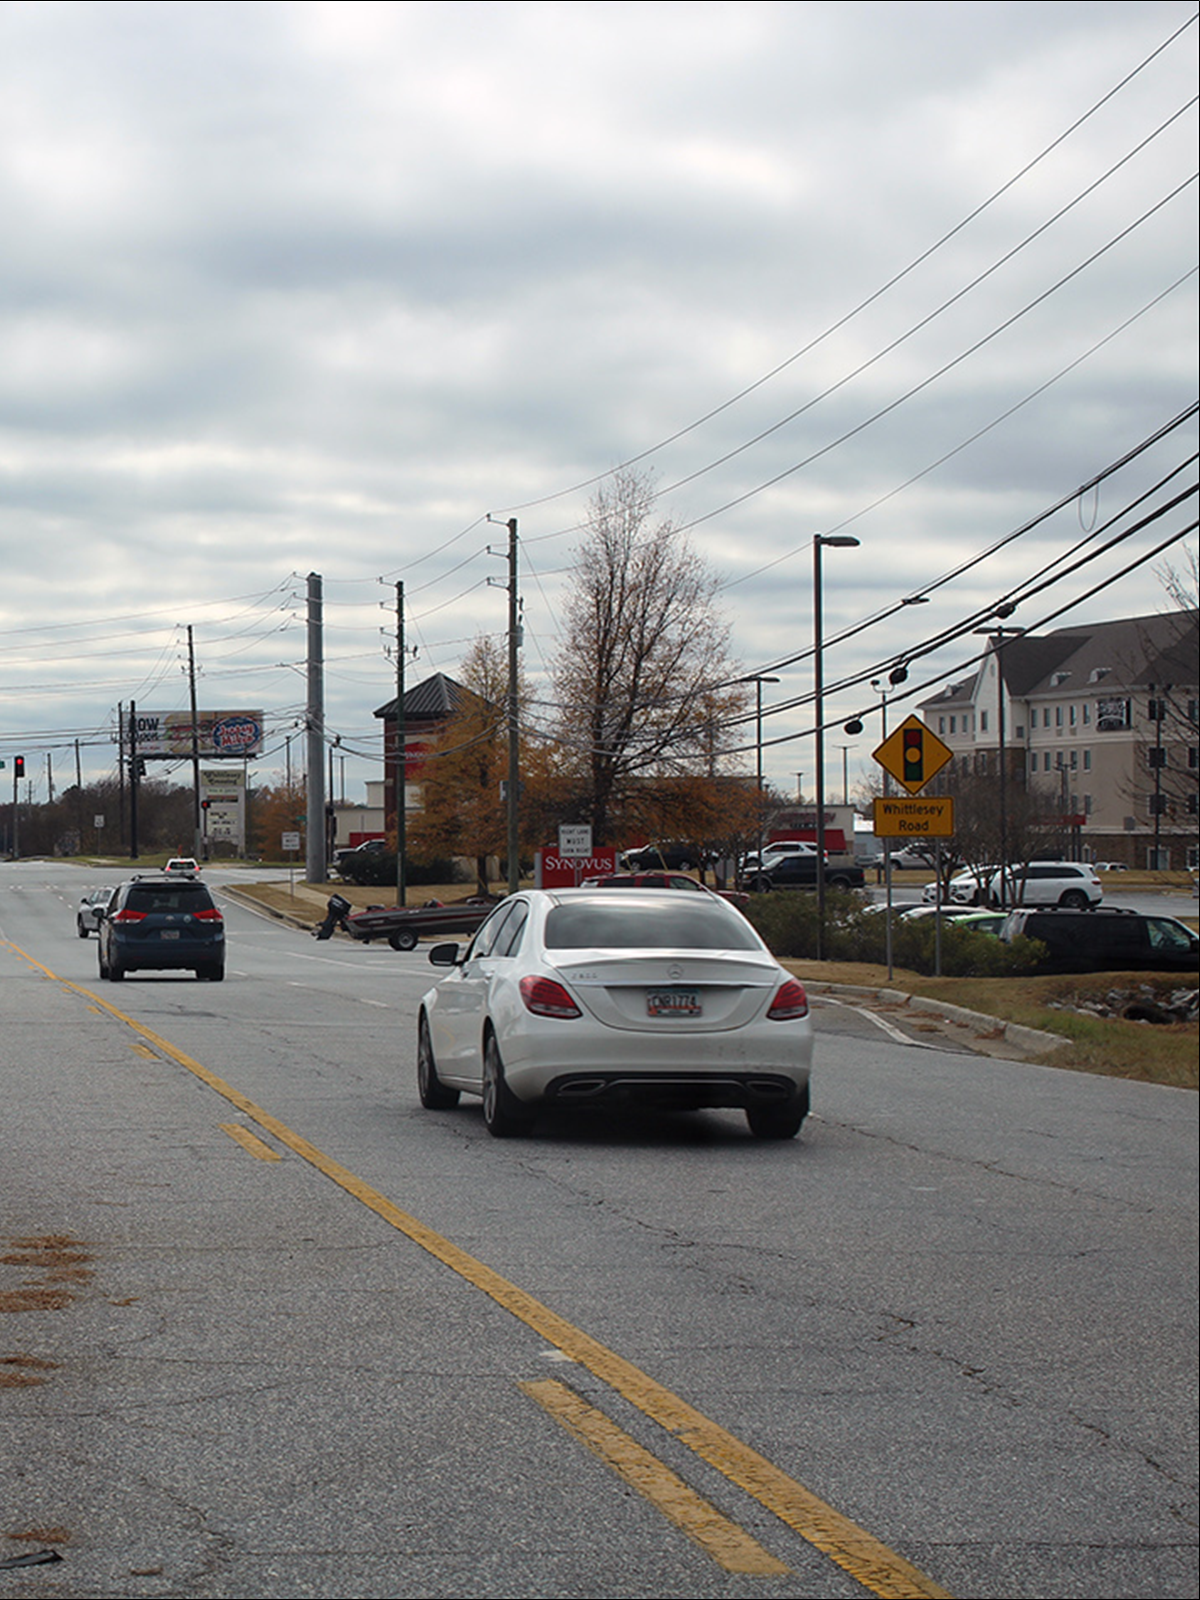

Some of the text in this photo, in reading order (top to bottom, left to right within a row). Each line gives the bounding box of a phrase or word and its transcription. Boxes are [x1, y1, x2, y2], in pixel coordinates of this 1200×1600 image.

[883, 803, 944, 817] Whittlesey
[899, 819, 929, 832] Road
[545, 856, 612, 871] SYNOVUS
